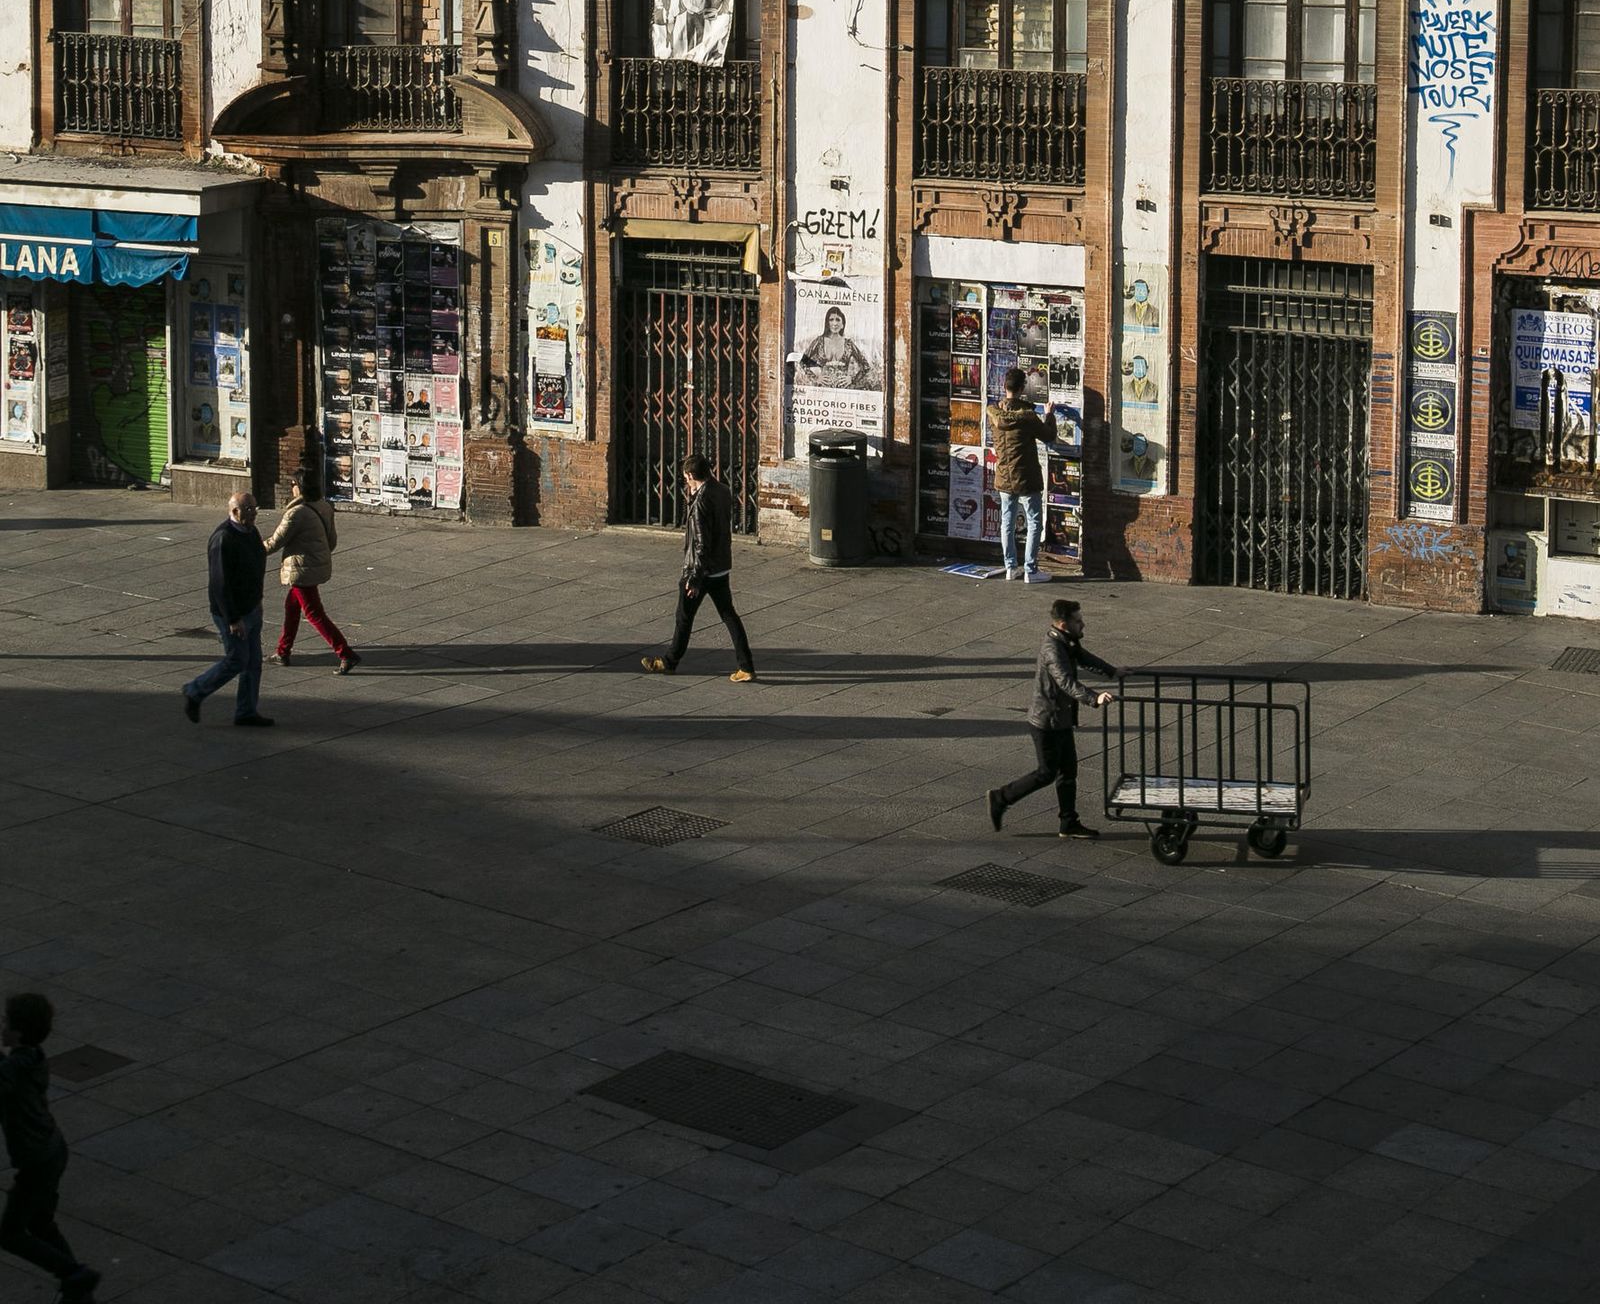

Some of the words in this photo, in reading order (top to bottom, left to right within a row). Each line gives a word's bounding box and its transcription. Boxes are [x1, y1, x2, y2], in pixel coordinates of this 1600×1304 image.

[1411, 31, 1496, 60] MUTE
[1410, 58, 1494, 85] NOSE
[1408, 83, 1492, 113] TOUR
[0, 242, 80, 276] LANA
[1544, 315, 1595, 324] INSTITUTO
[1544, 322, 1595, 336] KIROS
[1515, 345, 1596, 364] QUIROMASAJE
[792, 398, 847, 409] AUDITORIO
[850, 402, 876, 411] FIBES
[815, 418, 853, 428] MARZO
